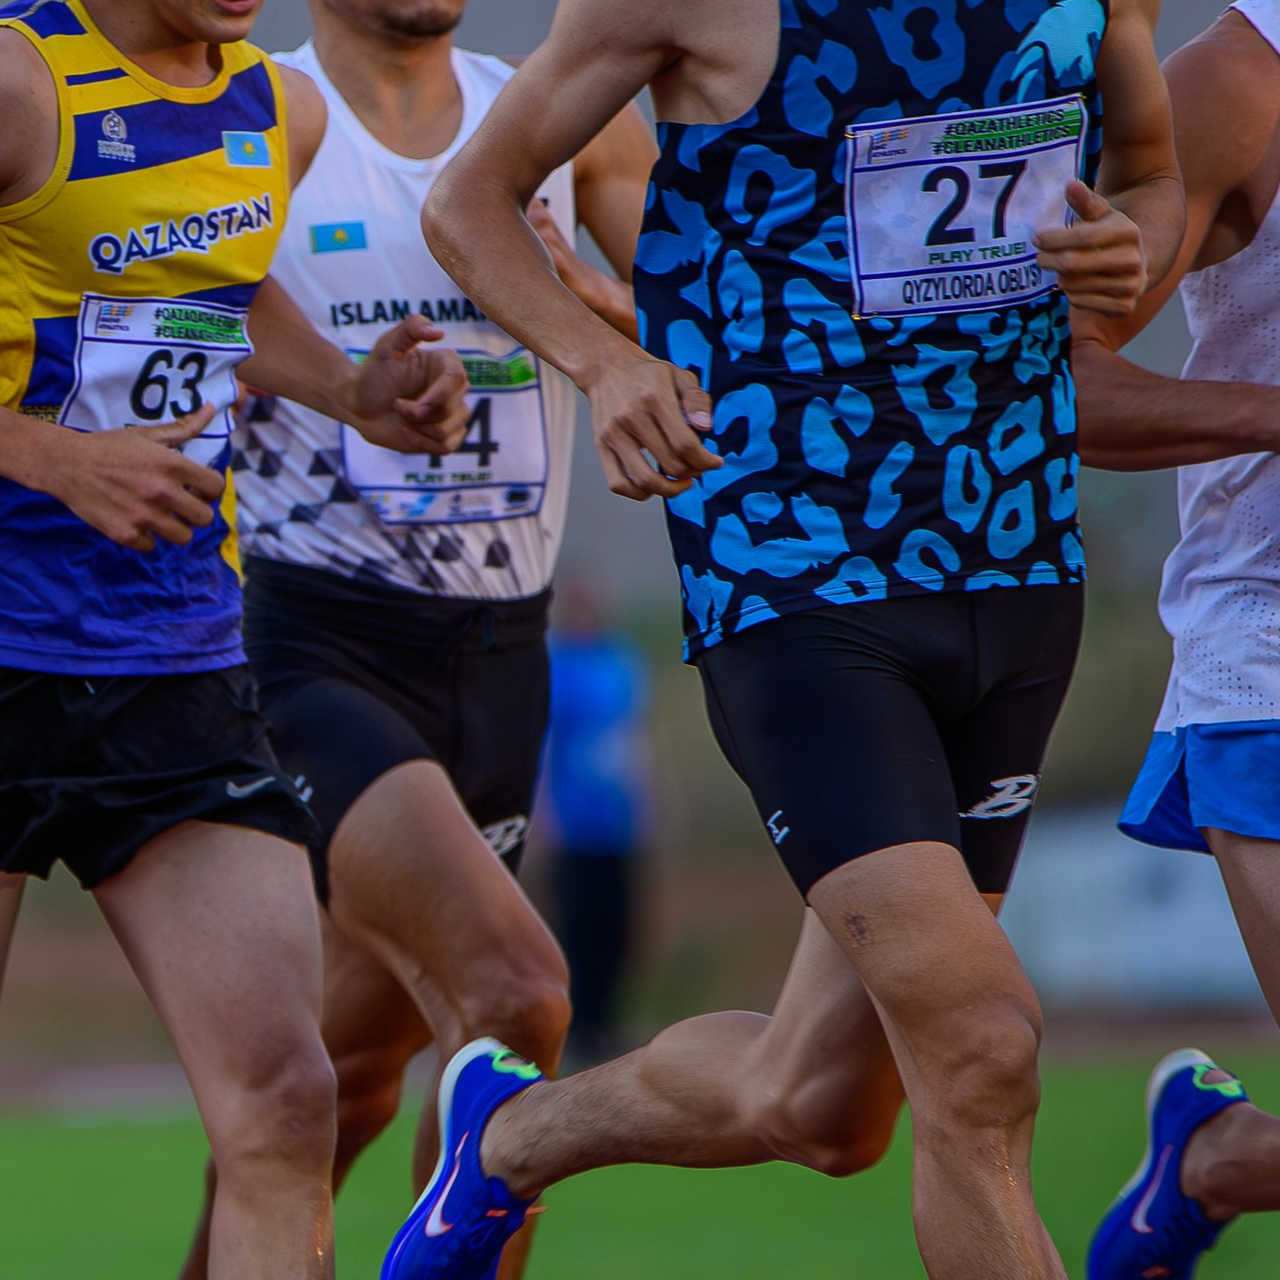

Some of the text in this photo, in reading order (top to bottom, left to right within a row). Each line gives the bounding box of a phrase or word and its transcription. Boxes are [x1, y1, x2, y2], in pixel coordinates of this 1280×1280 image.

[921, 158, 1028, 246] 27
[89, 195, 273, 273] QAZAQSTAN
[928, 241, 1027, 265] PLAY TRUE!
[330, 297, 488, 327] ISLAM AMA
[902, 272, 996, 305] QYZYLORDA
[130, 349, 208, 420] 63
